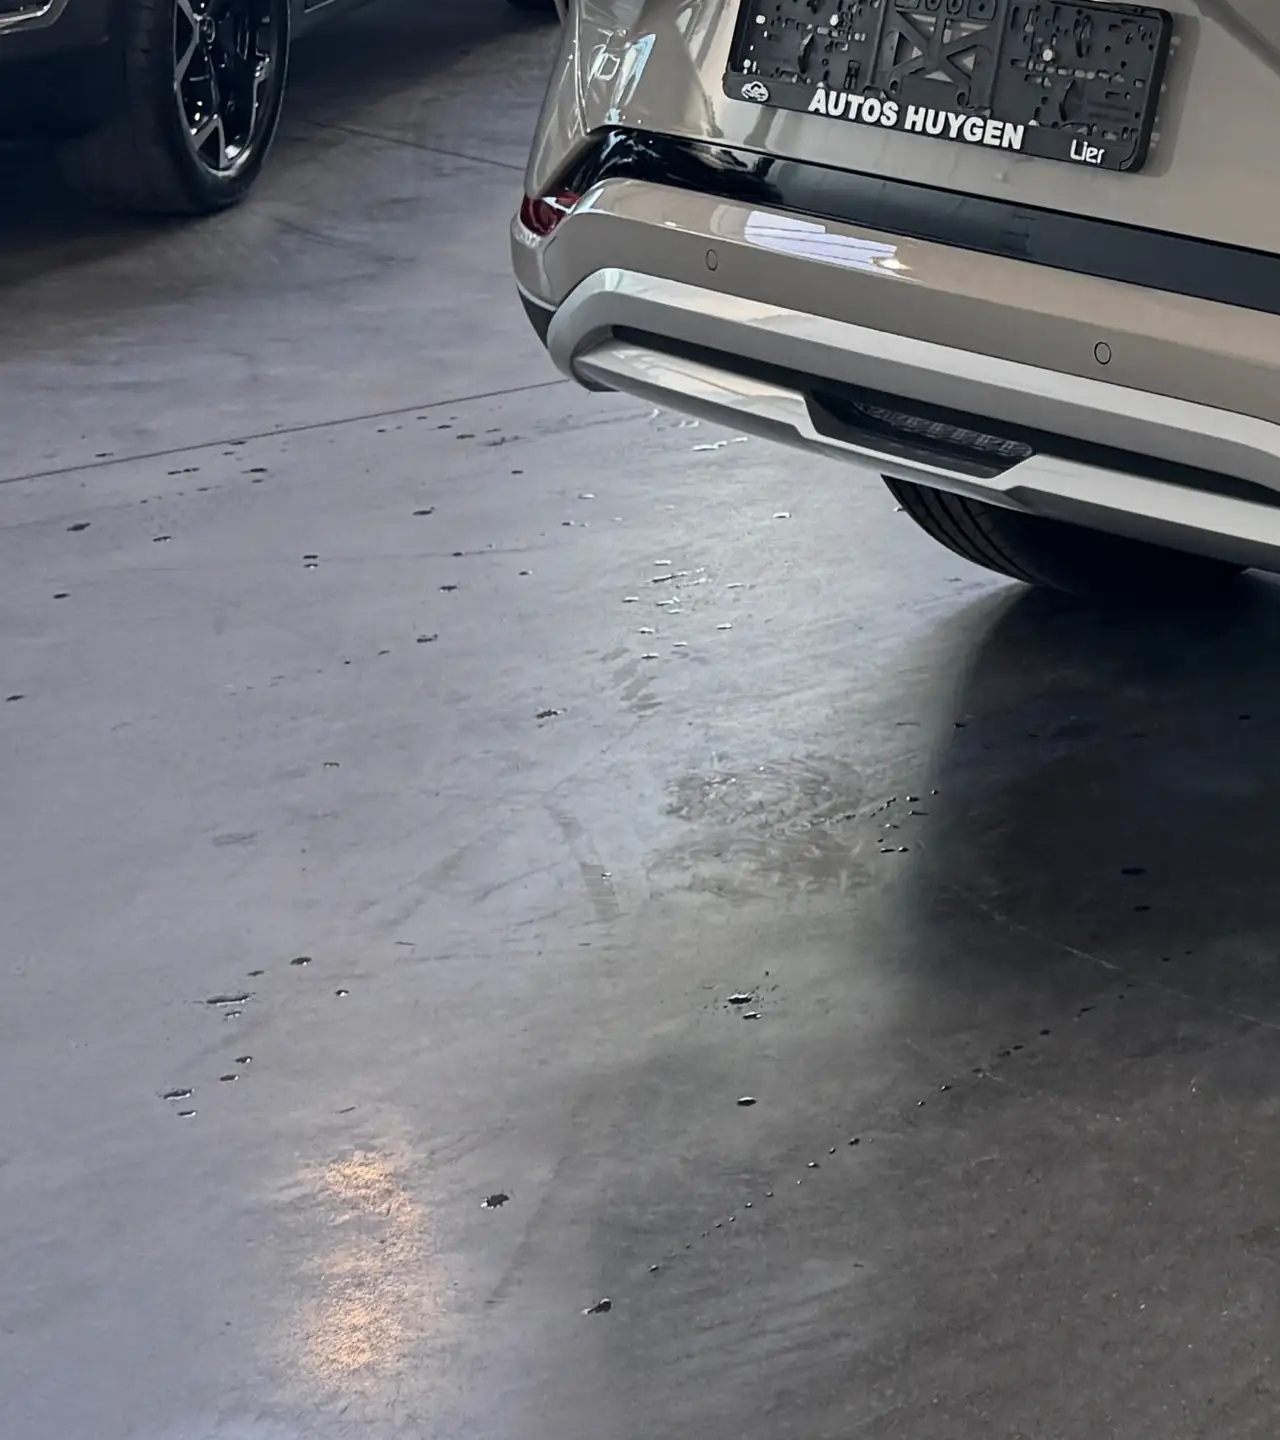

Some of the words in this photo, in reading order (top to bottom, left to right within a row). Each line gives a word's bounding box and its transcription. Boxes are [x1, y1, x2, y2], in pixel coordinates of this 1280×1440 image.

[808, 88, 899, 128] AUTOS
[904, 106, 1025, 150] HUYGEN
[1070, 139, 1105, 164] Lier
